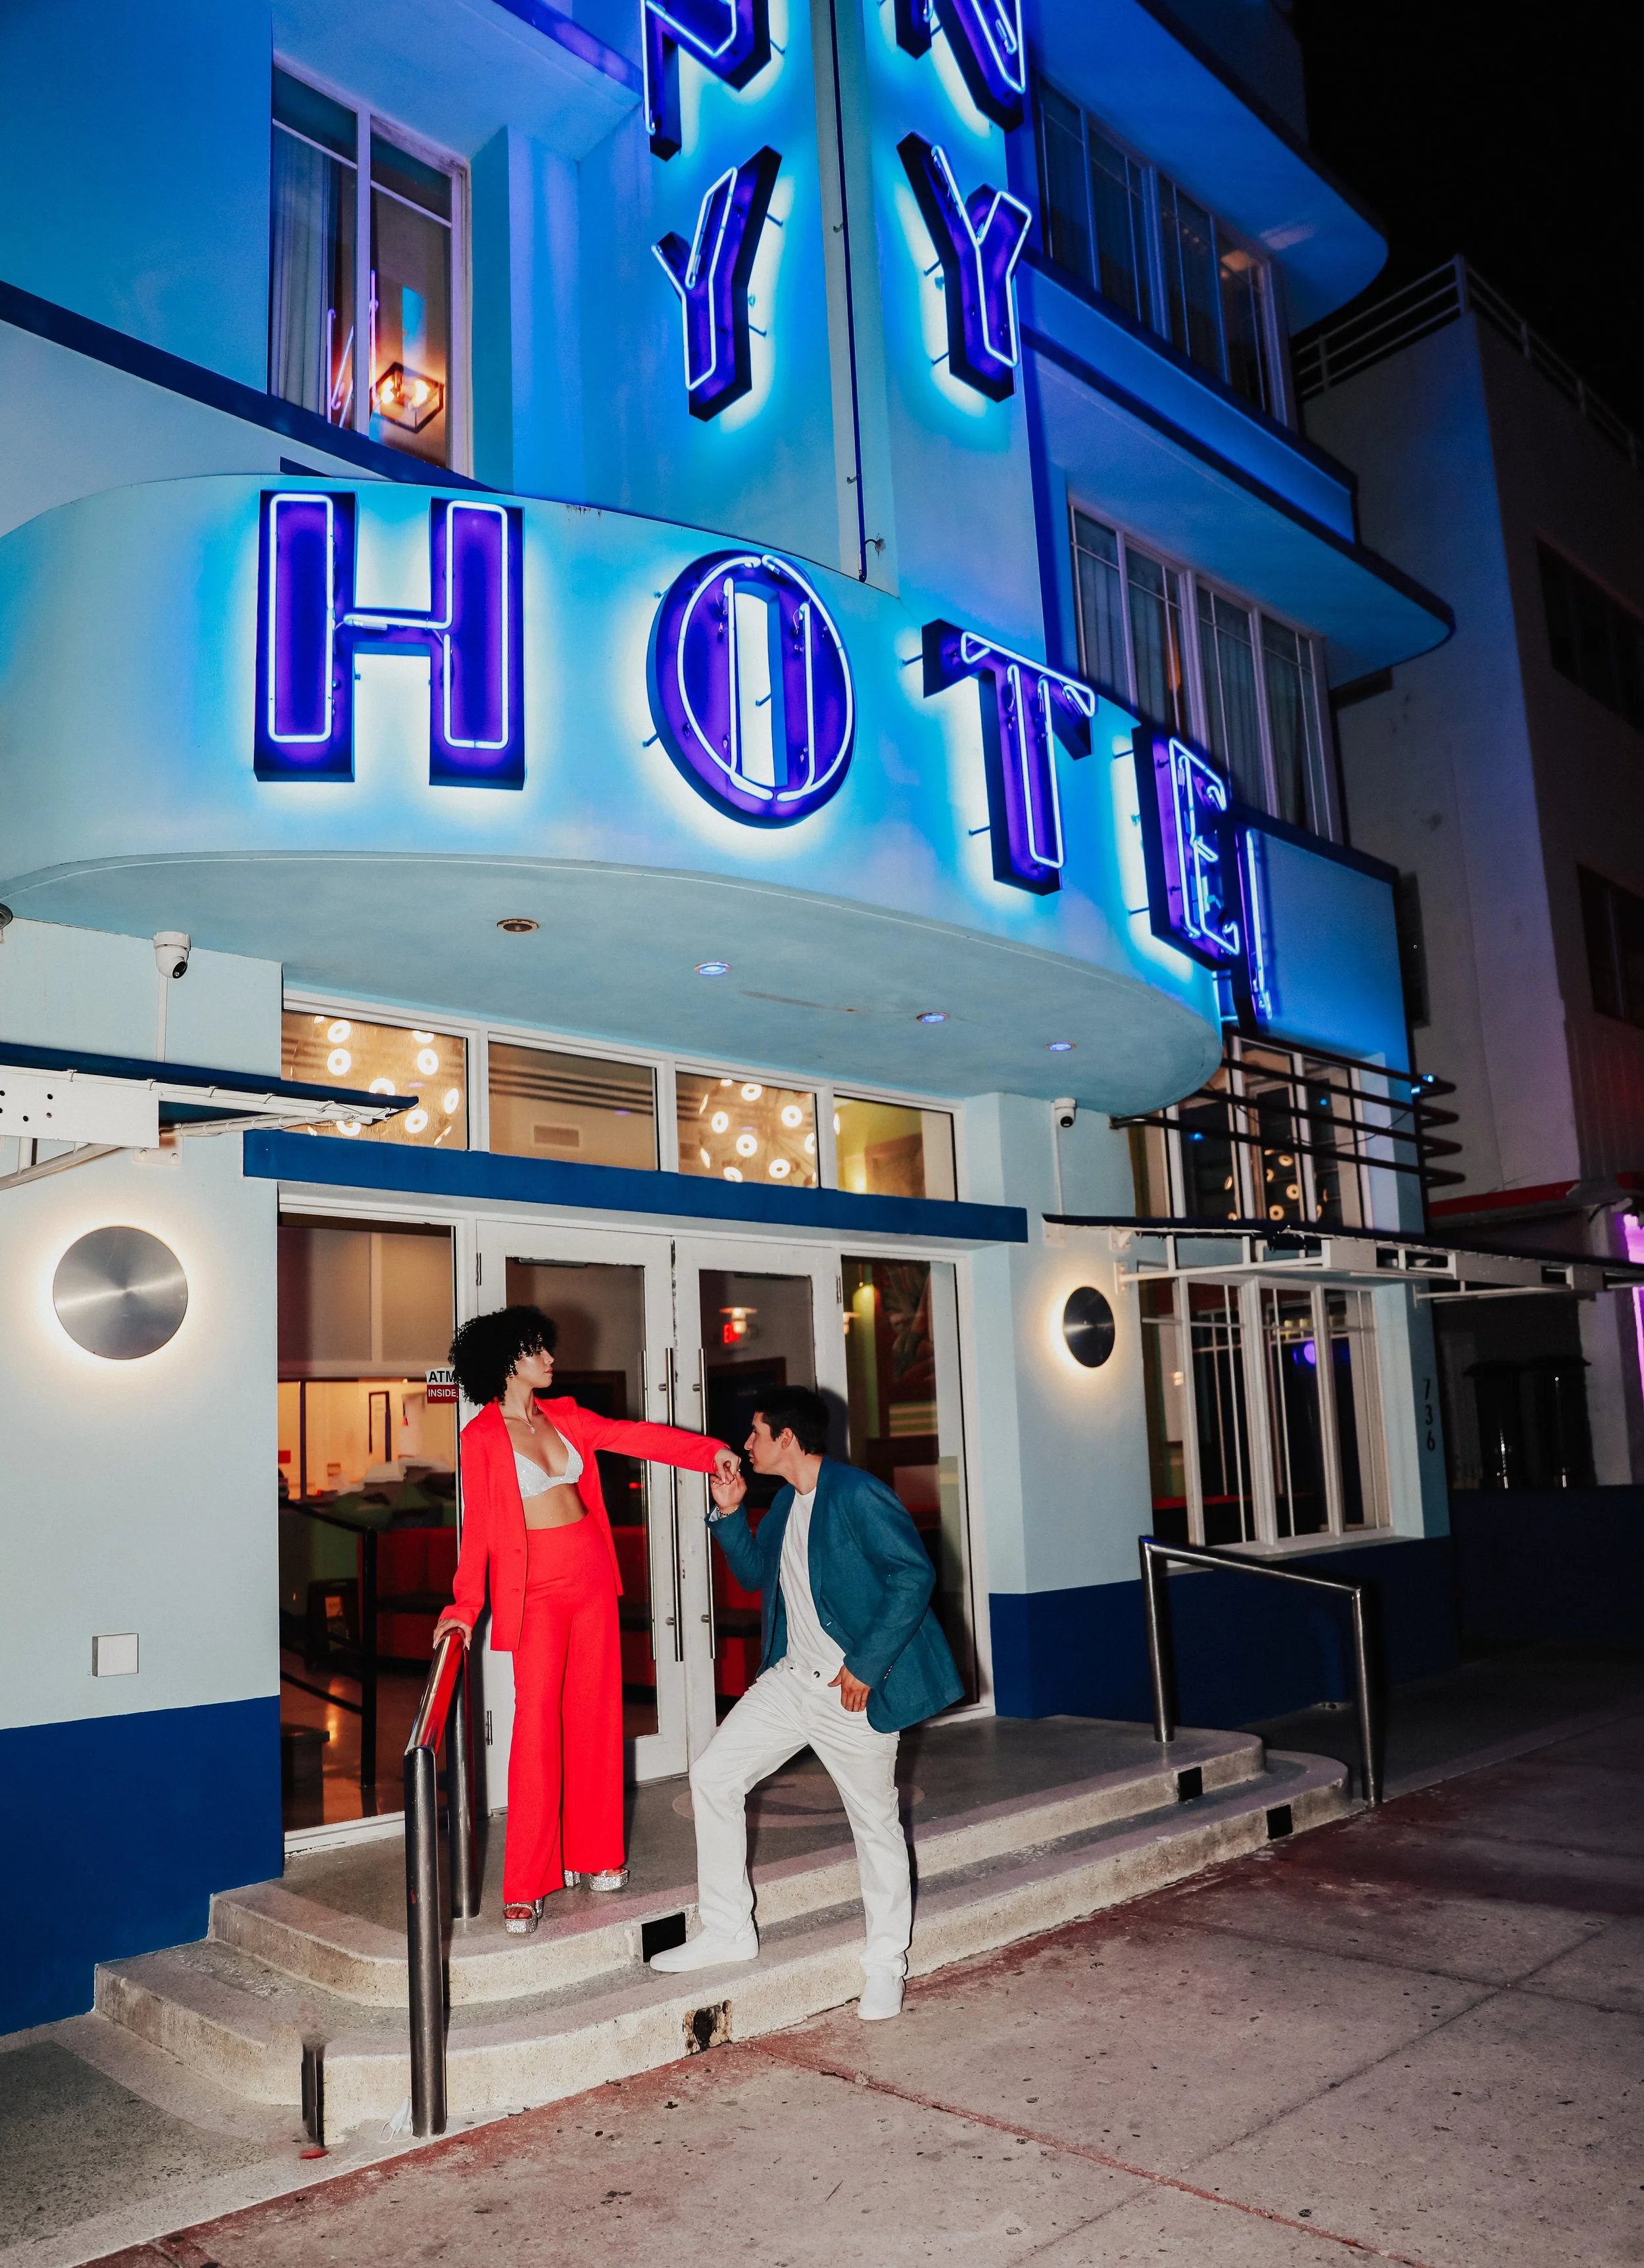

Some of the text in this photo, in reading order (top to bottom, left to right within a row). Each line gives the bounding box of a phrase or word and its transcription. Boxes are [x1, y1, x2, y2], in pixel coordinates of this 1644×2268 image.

[254, 490, 1273, 1034] HOTEL
[428, 1370, 455, 1383] ATM
[428, 1389, 456, 1397] INSIDE
[1422, 1378, 1436, 1451] 736
